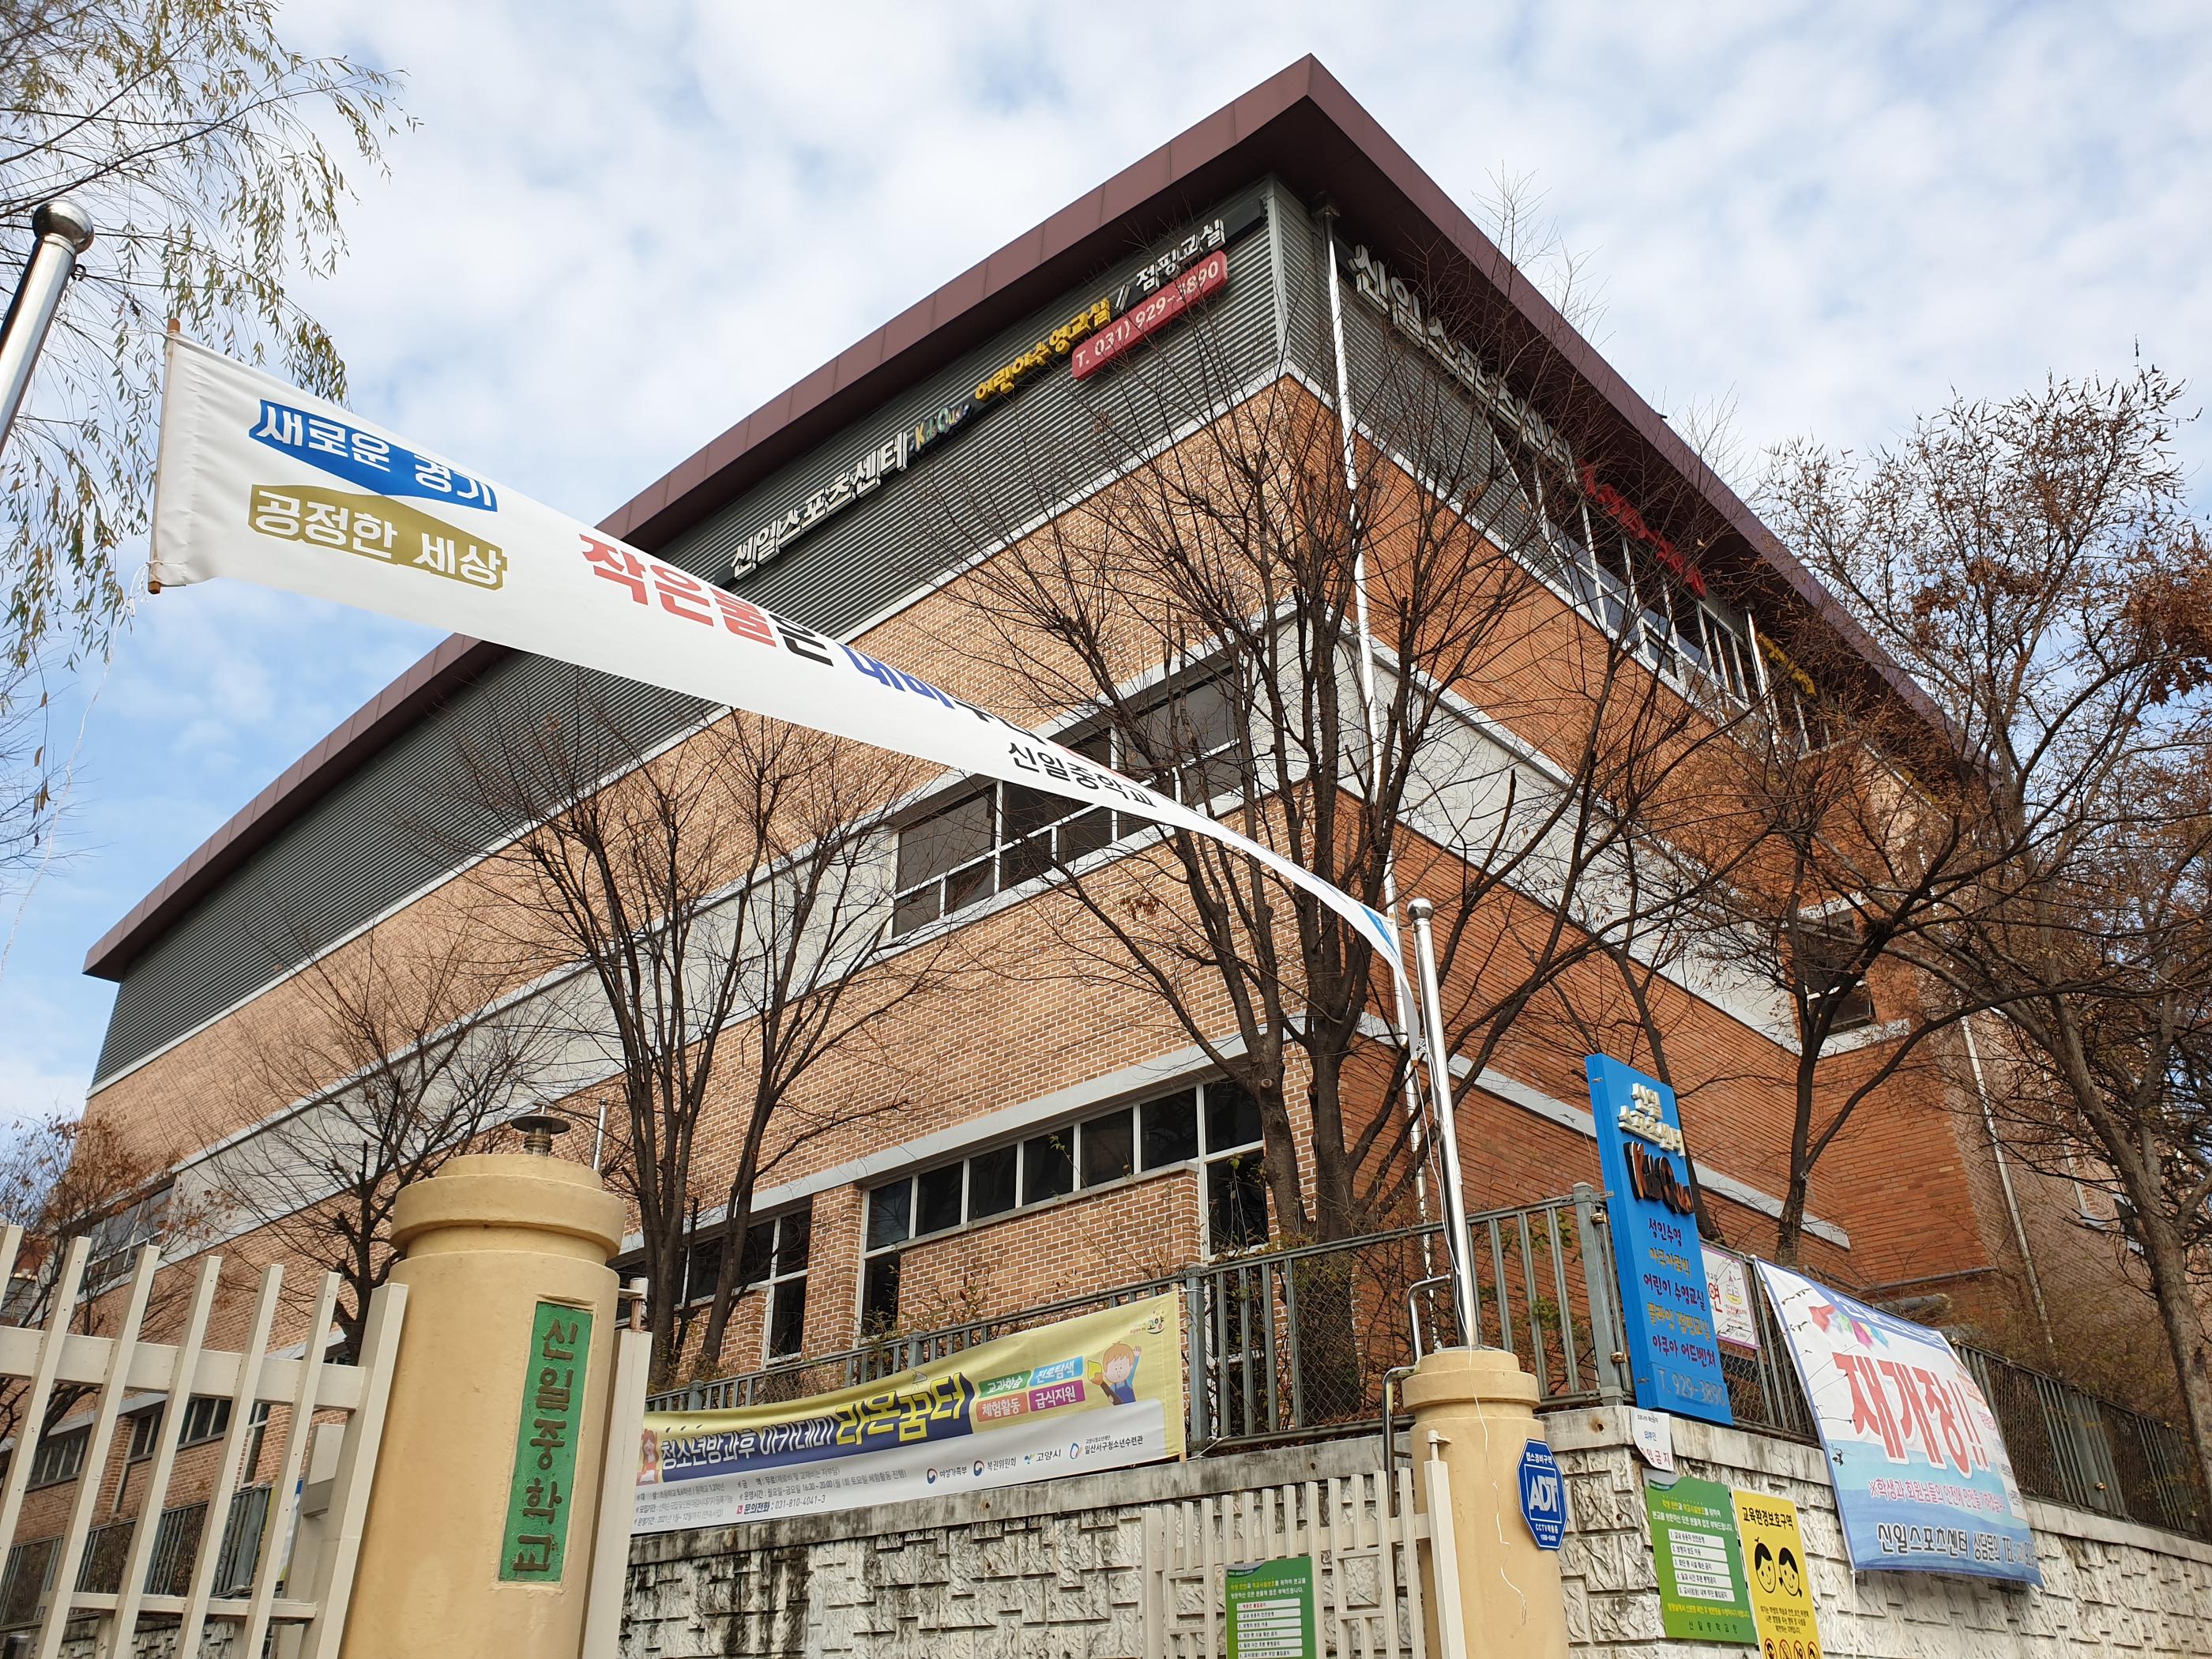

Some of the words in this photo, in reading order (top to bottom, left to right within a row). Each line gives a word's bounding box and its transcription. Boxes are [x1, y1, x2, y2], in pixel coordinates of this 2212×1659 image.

[256, 405, 391, 472] 새로운
[413, 454, 492, 506] 경기
[731, 431, 908, 581] 신일스포츠센터
[255, 491, 397, 559] 공정한
[413, 533, 501, 585] 세상
[1008, 743, 1157, 807] 신일중학교
[1631, 1082, 1663, 1119] 신일
[1618, 1105, 1685, 1157] 스포츠센터
[1649, 1217, 1682, 1247] 성인수영
[1643, 1273, 1672, 1296] 어린이
[1675, 1285, 1705, 1311] 수영교실
[1653, 1336, 1678, 1357] 아쿠아
[988, 1377, 1024, 1395] 교과학습
[1036, 1360, 1075, 1382] 진로탐색
[982, 1398, 1021, 1417] 체험활동
[1035, 1386, 1076, 1410] 급식지원
[1832, 1352, 1990, 1474] 재개장!!
[661, 1428, 756, 1469] 청소년방과후
[760, 1416, 832, 1454] 아카데미
[835, 1372, 969, 1446] 라온꿈터
[514, 1317, 578, 1571] 신일중학교
[1036, 1448, 1062, 1462] 고양시
[1085, 1435, 1144, 1454] 일산서구청소년수련관
[939, 1466, 968, 1479] 여성가족부
[744, 1501, 770, 1514] 문의전화
[775, 1494, 826, 1510] 031-810-4041-3
[1529, 1475, 1558, 1513] ADT
[1905, 1480, 1943, 1503] 회원님들의
[1742, 1507, 1794, 1531] 교육환경보호구역
[1878, 1523, 1968, 1558] 신일스포츠센터
[1973, 1532, 2000, 1562] 상담문의
